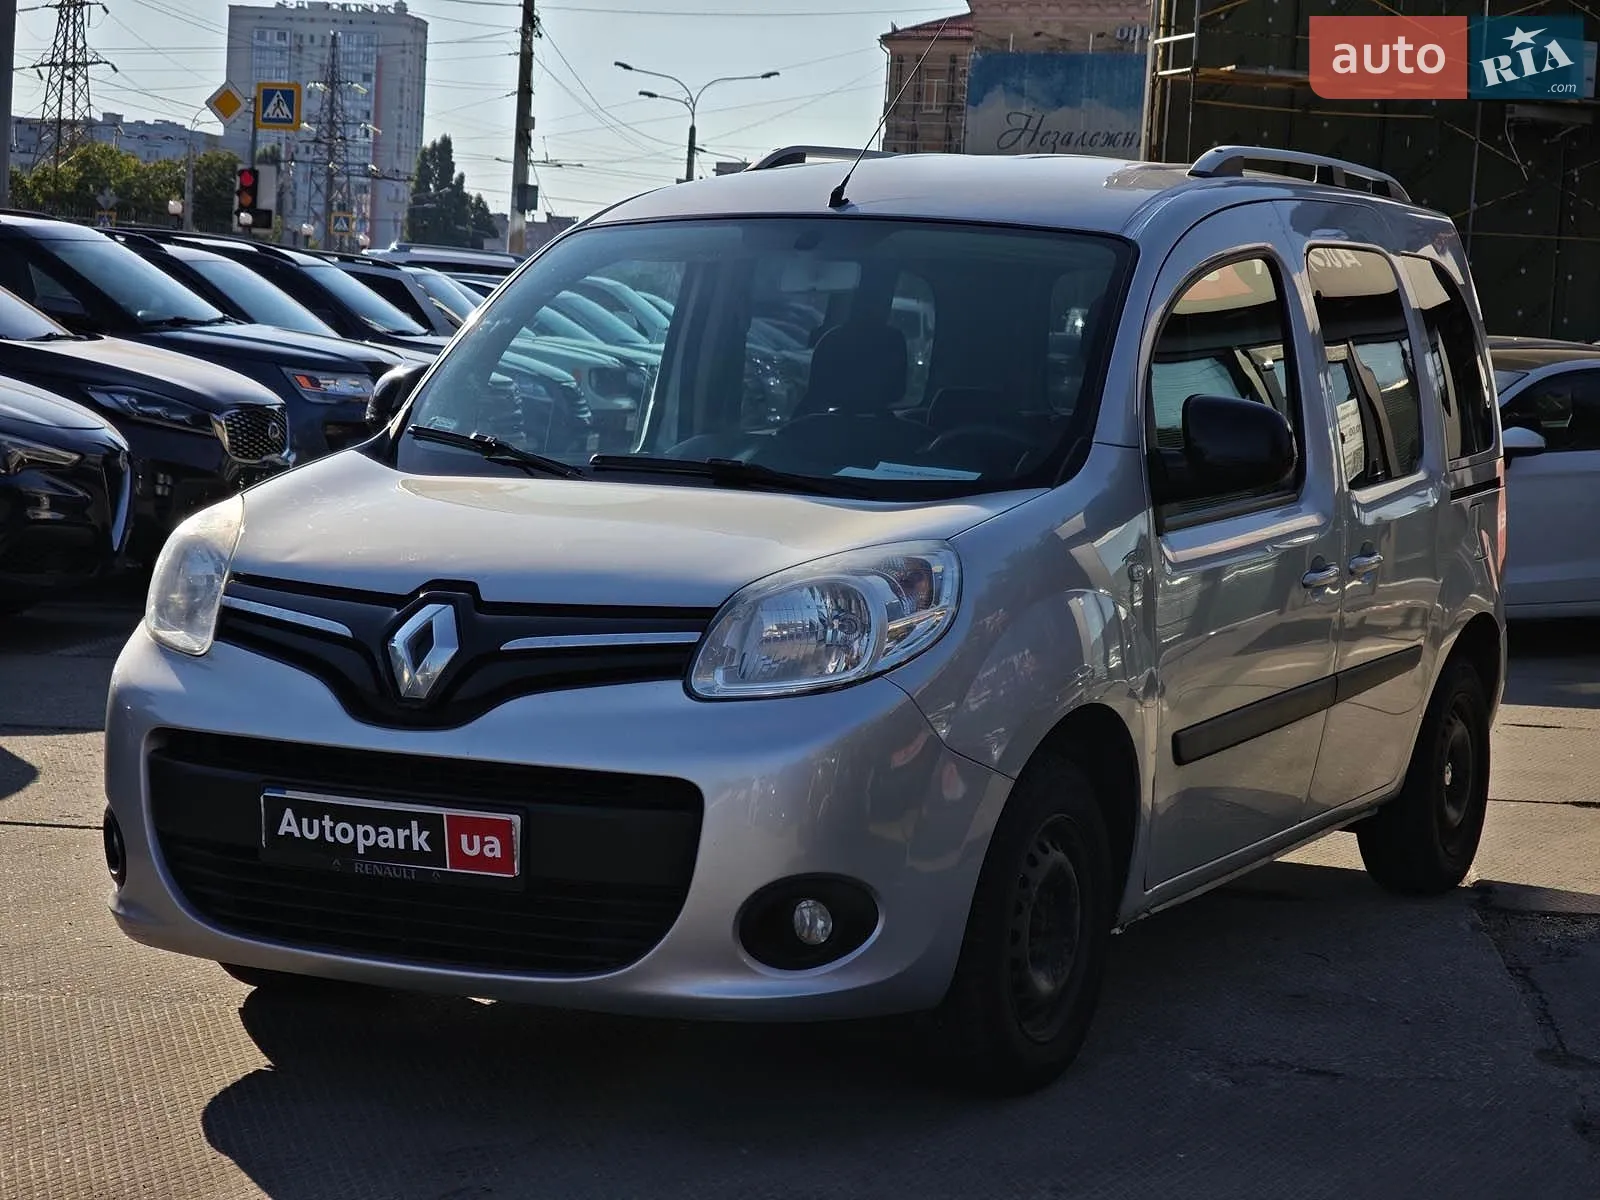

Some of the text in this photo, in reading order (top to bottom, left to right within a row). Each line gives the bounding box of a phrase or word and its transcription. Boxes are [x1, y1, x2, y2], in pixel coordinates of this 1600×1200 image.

[277, 807, 502, 859] Autopark ua
[354, 862, 417, 880] RENAULT
